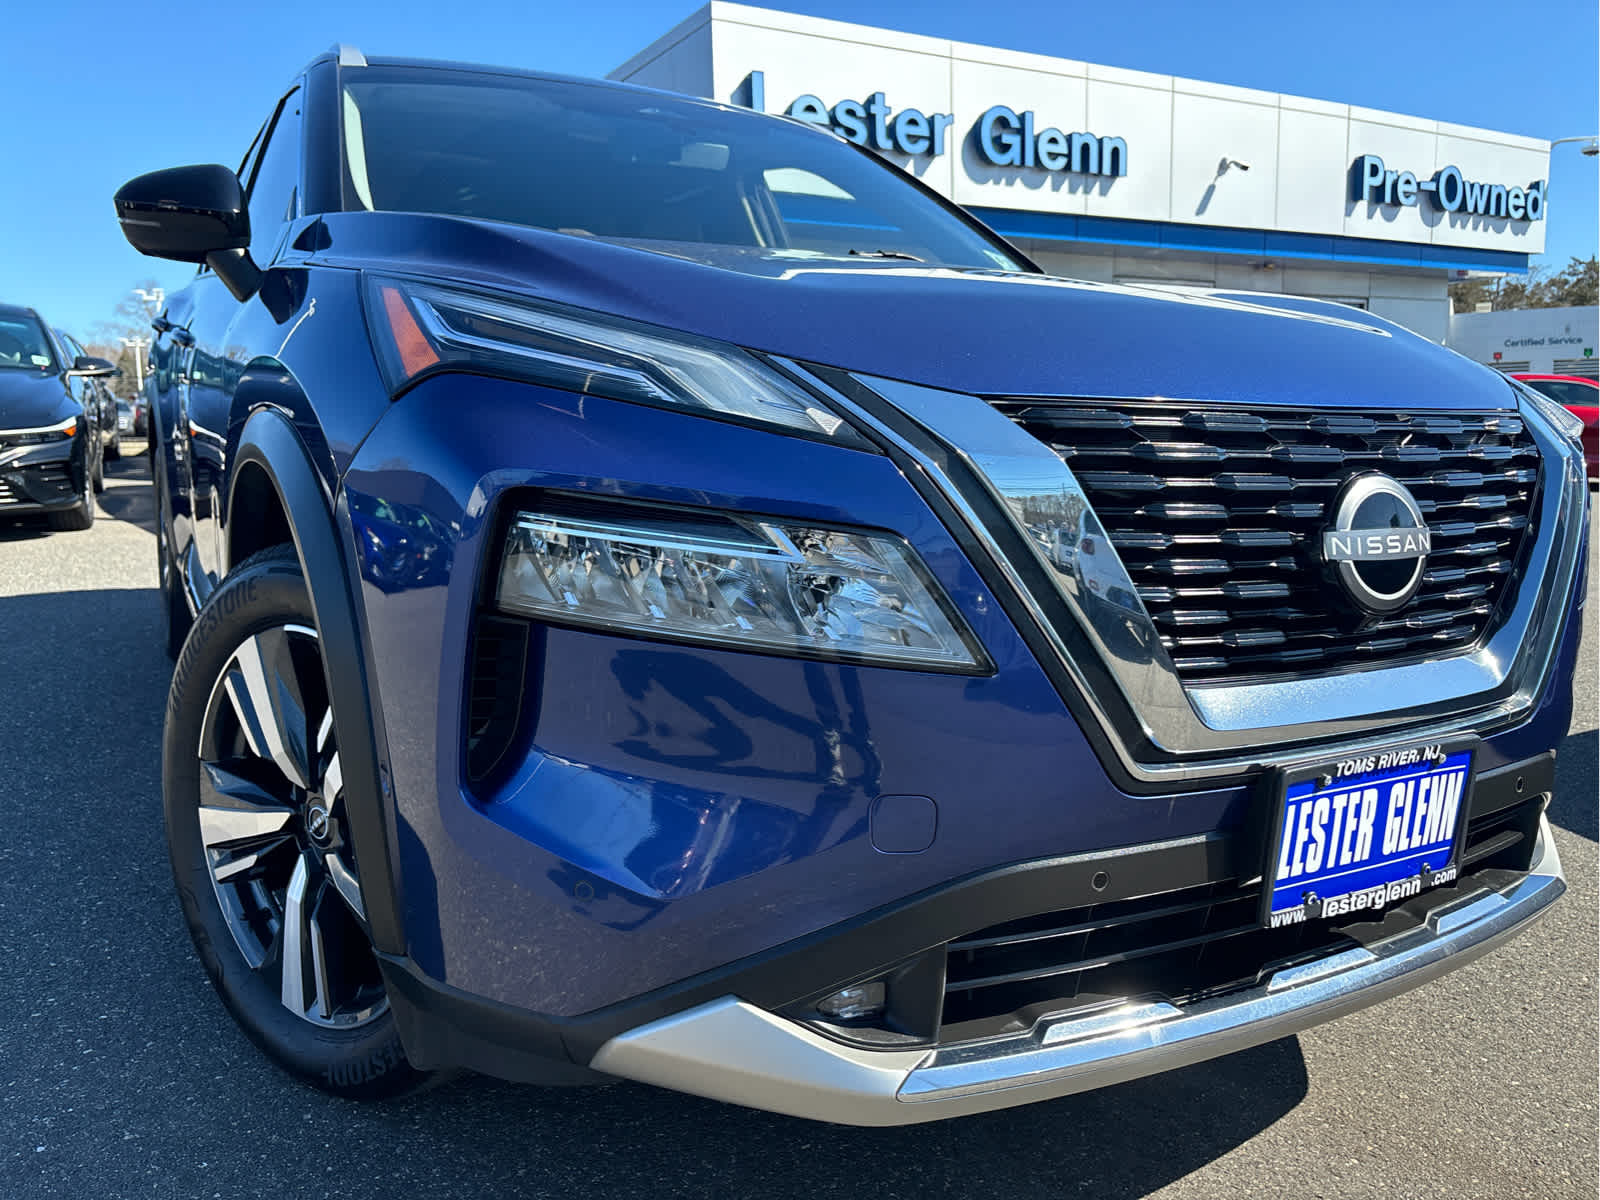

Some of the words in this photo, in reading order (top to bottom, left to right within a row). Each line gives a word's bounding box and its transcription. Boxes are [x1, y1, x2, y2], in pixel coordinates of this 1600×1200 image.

[972, 104, 1129, 178] Glenn
[1355, 153, 1547, 222] Pre-Owned
[1503, 337, 1545, 348] Certified
[1548, 336, 1583, 345] Service
[1330, 532, 1430, 556] NISSAN
[1336, 757, 1376, 777] TOMS
[1377, 748, 1420, 769] RIVER,
[1422, 743, 1441, 760] NJ
[1275, 788, 1379, 881] LESTER
[1382, 771, 1465, 856] GLENN
[1320, 875, 1421, 918] lesterglenn
